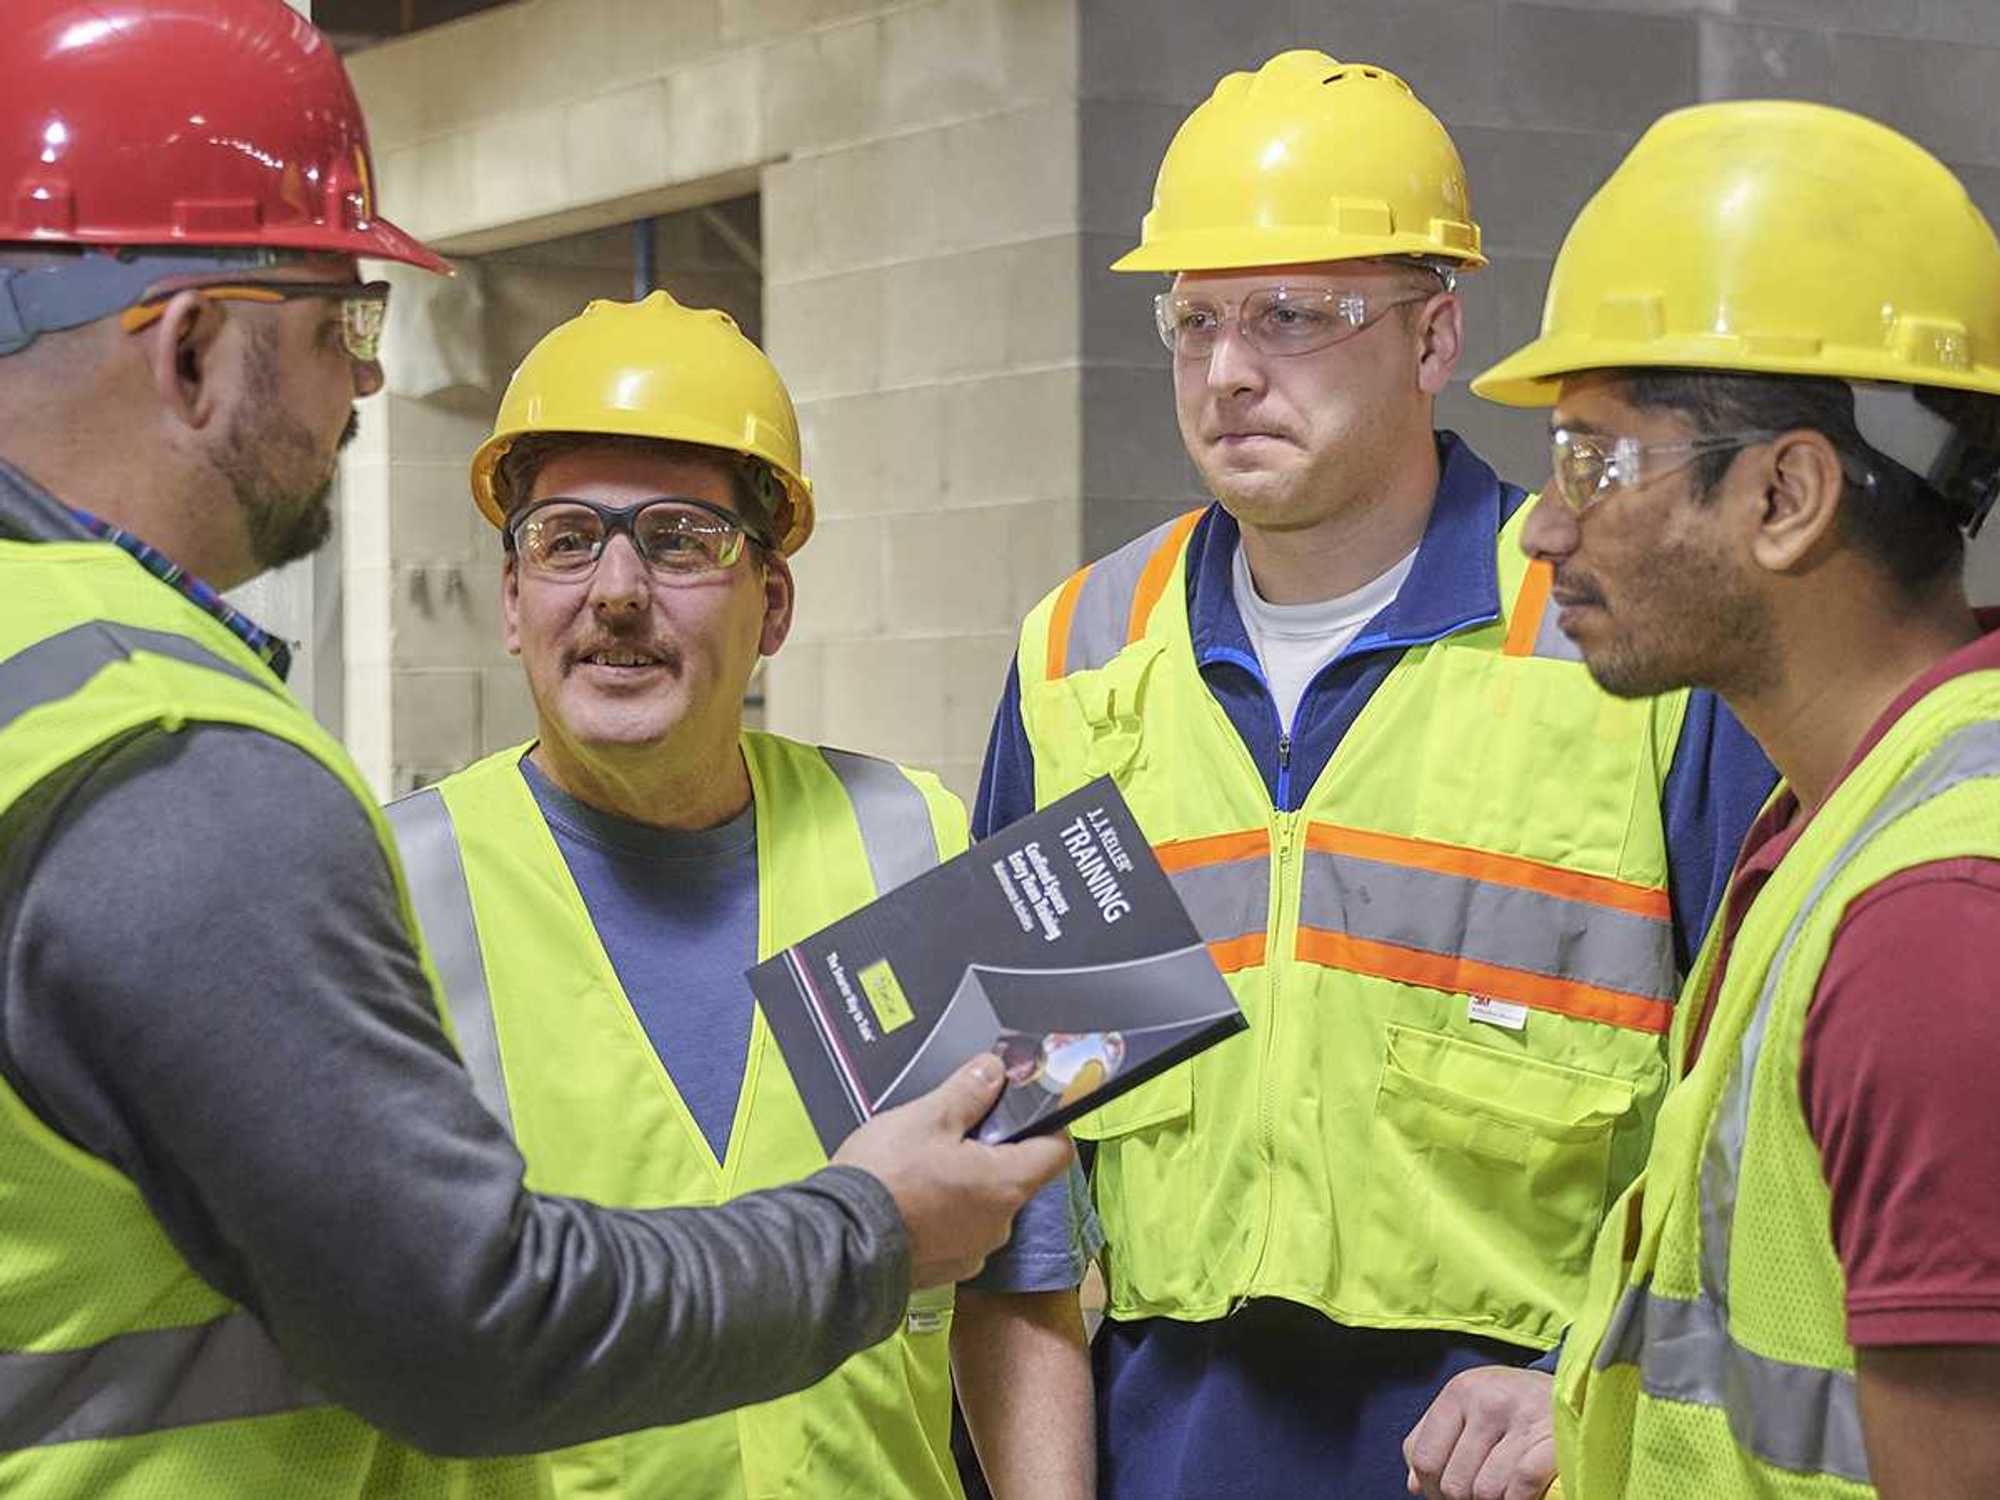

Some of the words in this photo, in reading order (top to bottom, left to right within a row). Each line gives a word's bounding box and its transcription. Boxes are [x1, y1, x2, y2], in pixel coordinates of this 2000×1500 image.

[1025, 842, 1057, 885] Confined
[1059, 817, 1131, 923] TRAINING
[1034, 897, 1062, 941] Training
